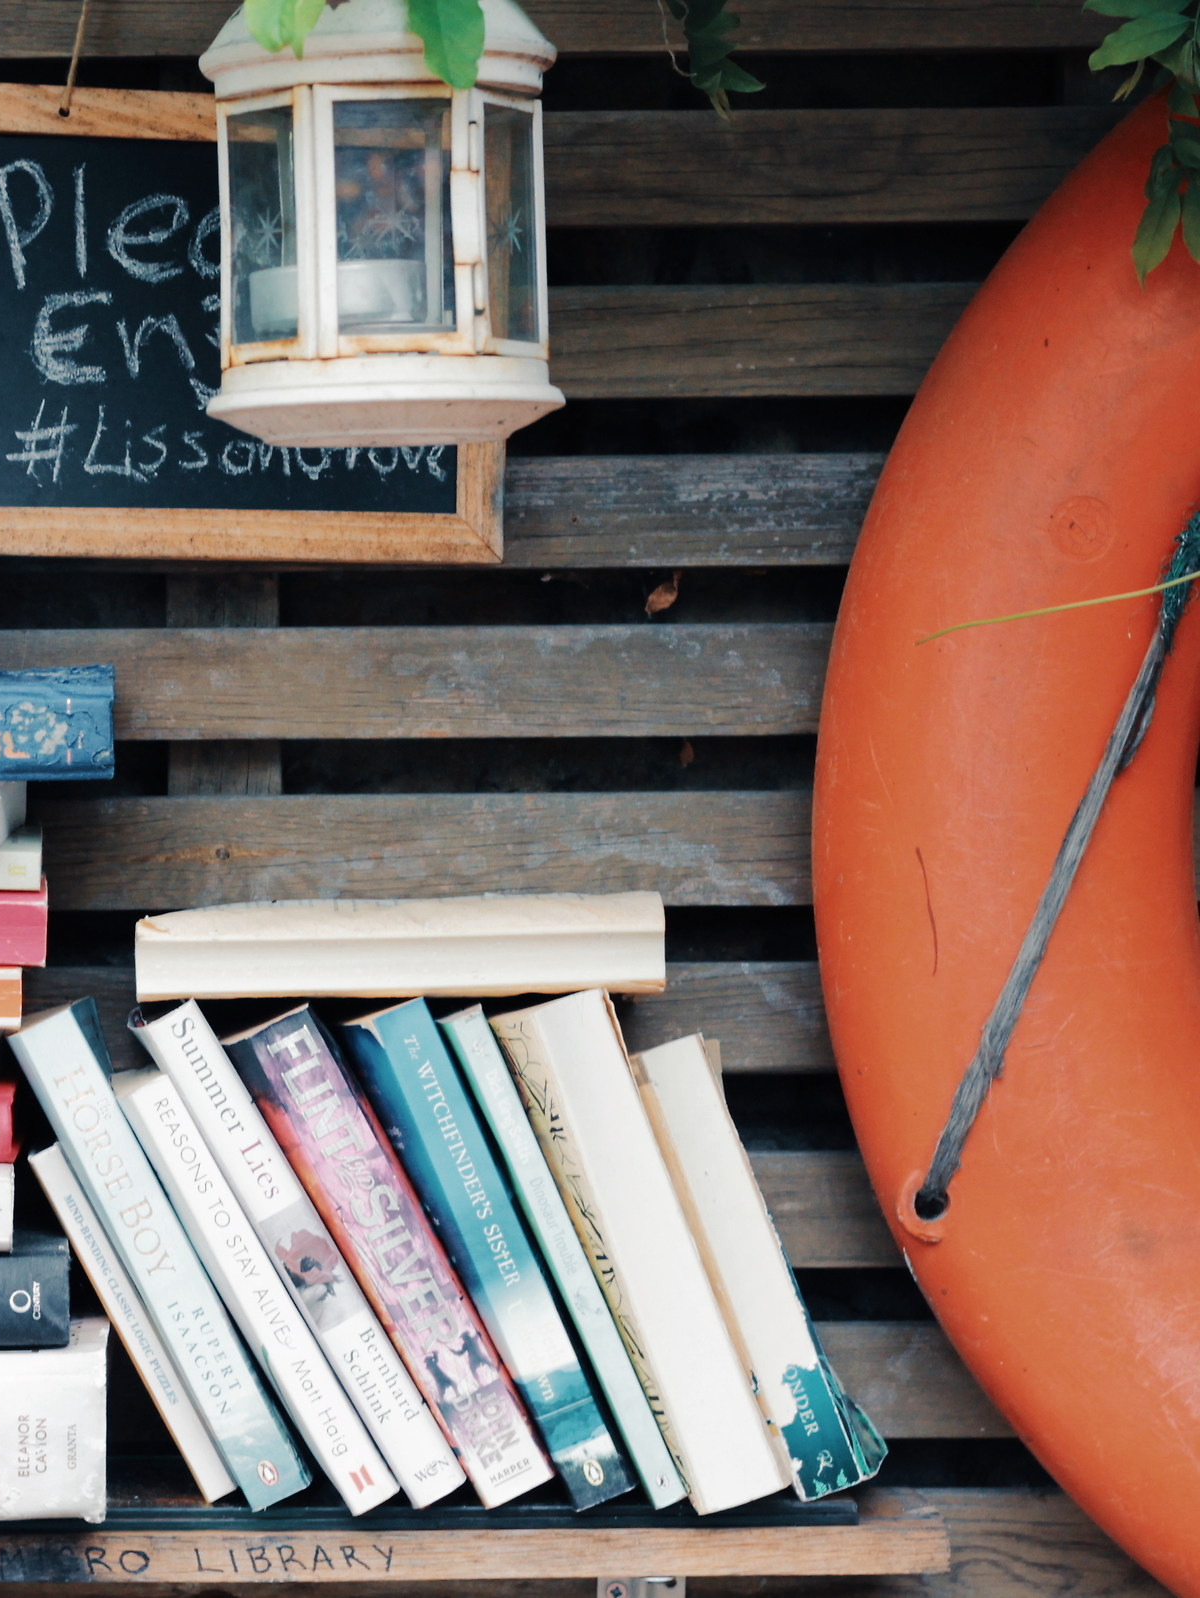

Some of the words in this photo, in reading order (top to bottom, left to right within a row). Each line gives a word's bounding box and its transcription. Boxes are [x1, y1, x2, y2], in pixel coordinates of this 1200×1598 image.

[170, 1016, 245, 1135] Summer
[238, 1137, 280, 1200] Lies
[403, 1034, 419, 1061] The
[418, 1060, 494, 1220] WITCHFINDER'S
[53, 1065, 135, 1200] HORSE
[119, 1195, 177, 1276] BOY
[267, 1023, 363, 1167] FLINT
[351, 1186, 461, 1353] SILVER
[154, 1097, 213, 1195] REASONS
[207, 1188, 231, 1229] TO
[226, 1235, 259, 1280] STAY
[252, 1289, 294, 1347] ALIVE
[528, 1176, 561, 1232] Dinosaur
[550, 1230, 578, 1277] Trouble
[63, 1193, 112, 1278] MIND-BENDING
[107, 1277, 136, 1324] CLASSIC
[130, 1322, 155, 1360] LOGIC
[149, 1357, 180, 1407] PUZZLES
[192, 1307, 241, 1391] RUPERT
[167, 1300, 231, 1416] ISAACSON
[343, 1350, 390, 1426] Schlink
[358, 1325, 419, 1423] Bernhard
[17, 1414, 31, 1478] ELEANOR
[66, 1424, 78, 1470] GRANTA
[291, 1359, 322, 1403] Matt
[318, 1407, 349, 1457] Haig
[452, 1394, 504, 1470] DRAKE
[476, 1391, 520, 1452] JOHN
[414, 1458, 452, 1484] W&N
[489, 1458, 531, 1484] HARPER
[194, 1544, 395, 1575] LIBRARY
